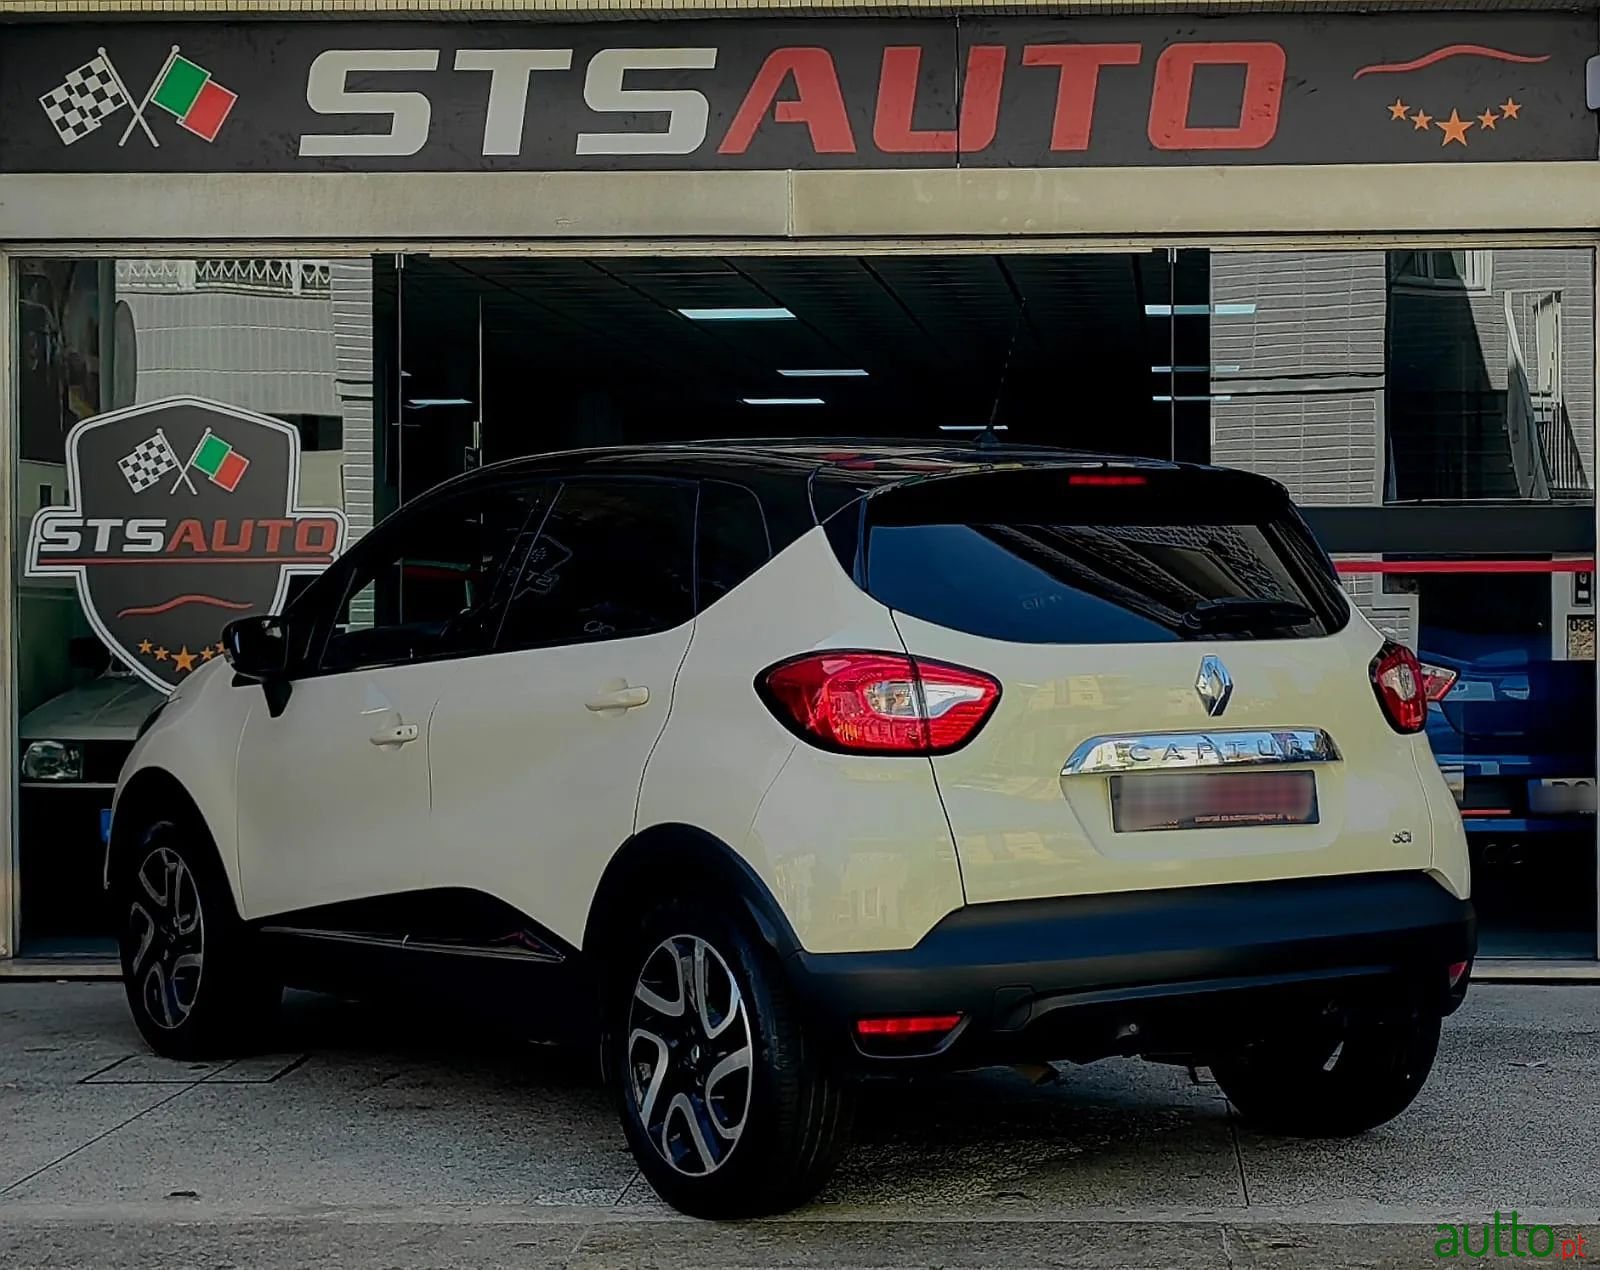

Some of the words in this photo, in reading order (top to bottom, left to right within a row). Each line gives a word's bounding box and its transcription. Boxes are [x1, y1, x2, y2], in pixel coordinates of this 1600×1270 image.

[298, 41, 1286, 157] STSAUTO
[40, 518, 336, 553] STSAUTO
[1129, 740, 1306, 761] CAPTUR
